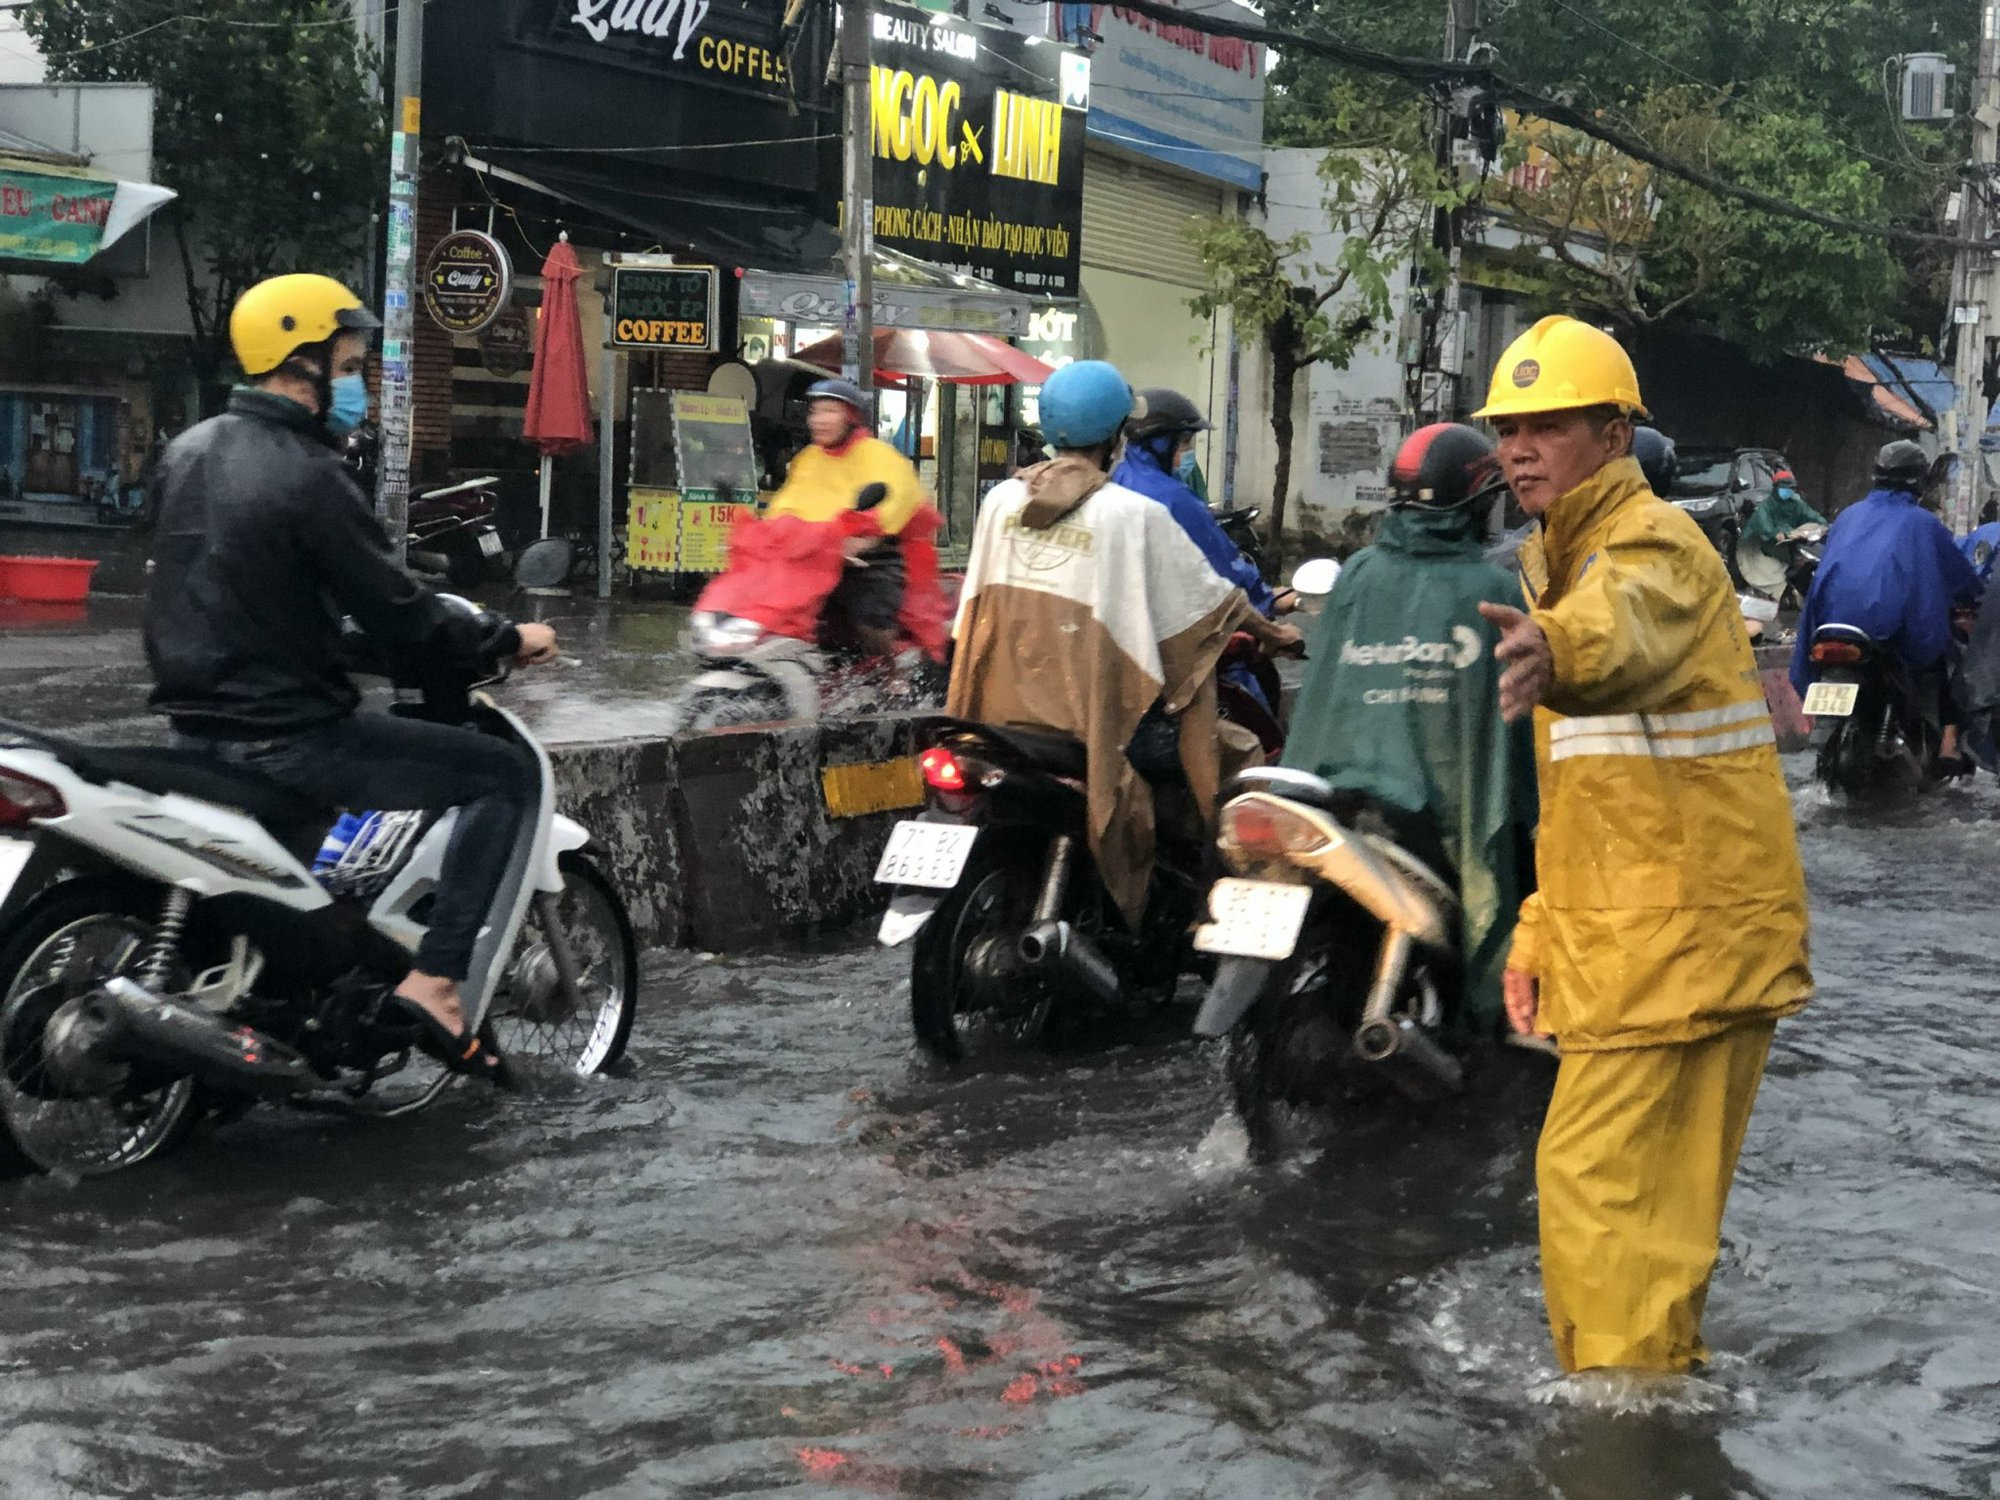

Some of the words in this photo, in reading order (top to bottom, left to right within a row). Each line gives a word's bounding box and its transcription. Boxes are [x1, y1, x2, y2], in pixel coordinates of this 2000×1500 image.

[870, 64, 960, 188] NGỌC
[992, 86, 1063, 186] LINH
[874, 205, 910, 239] PHONG
[913, 203, 942, 242] CÁCH
[949, 209, 980, 252] NHẬN
[1003, 223, 1023, 257] TẠO
[1023, 227, 1044, 259] HỌC
[449, 246, 482, 259] Coffee
[617, 319, 705, 344] COFFEE
[709, 505, 736, 523] 15K
[1002, 513, 1093, 552] PER
